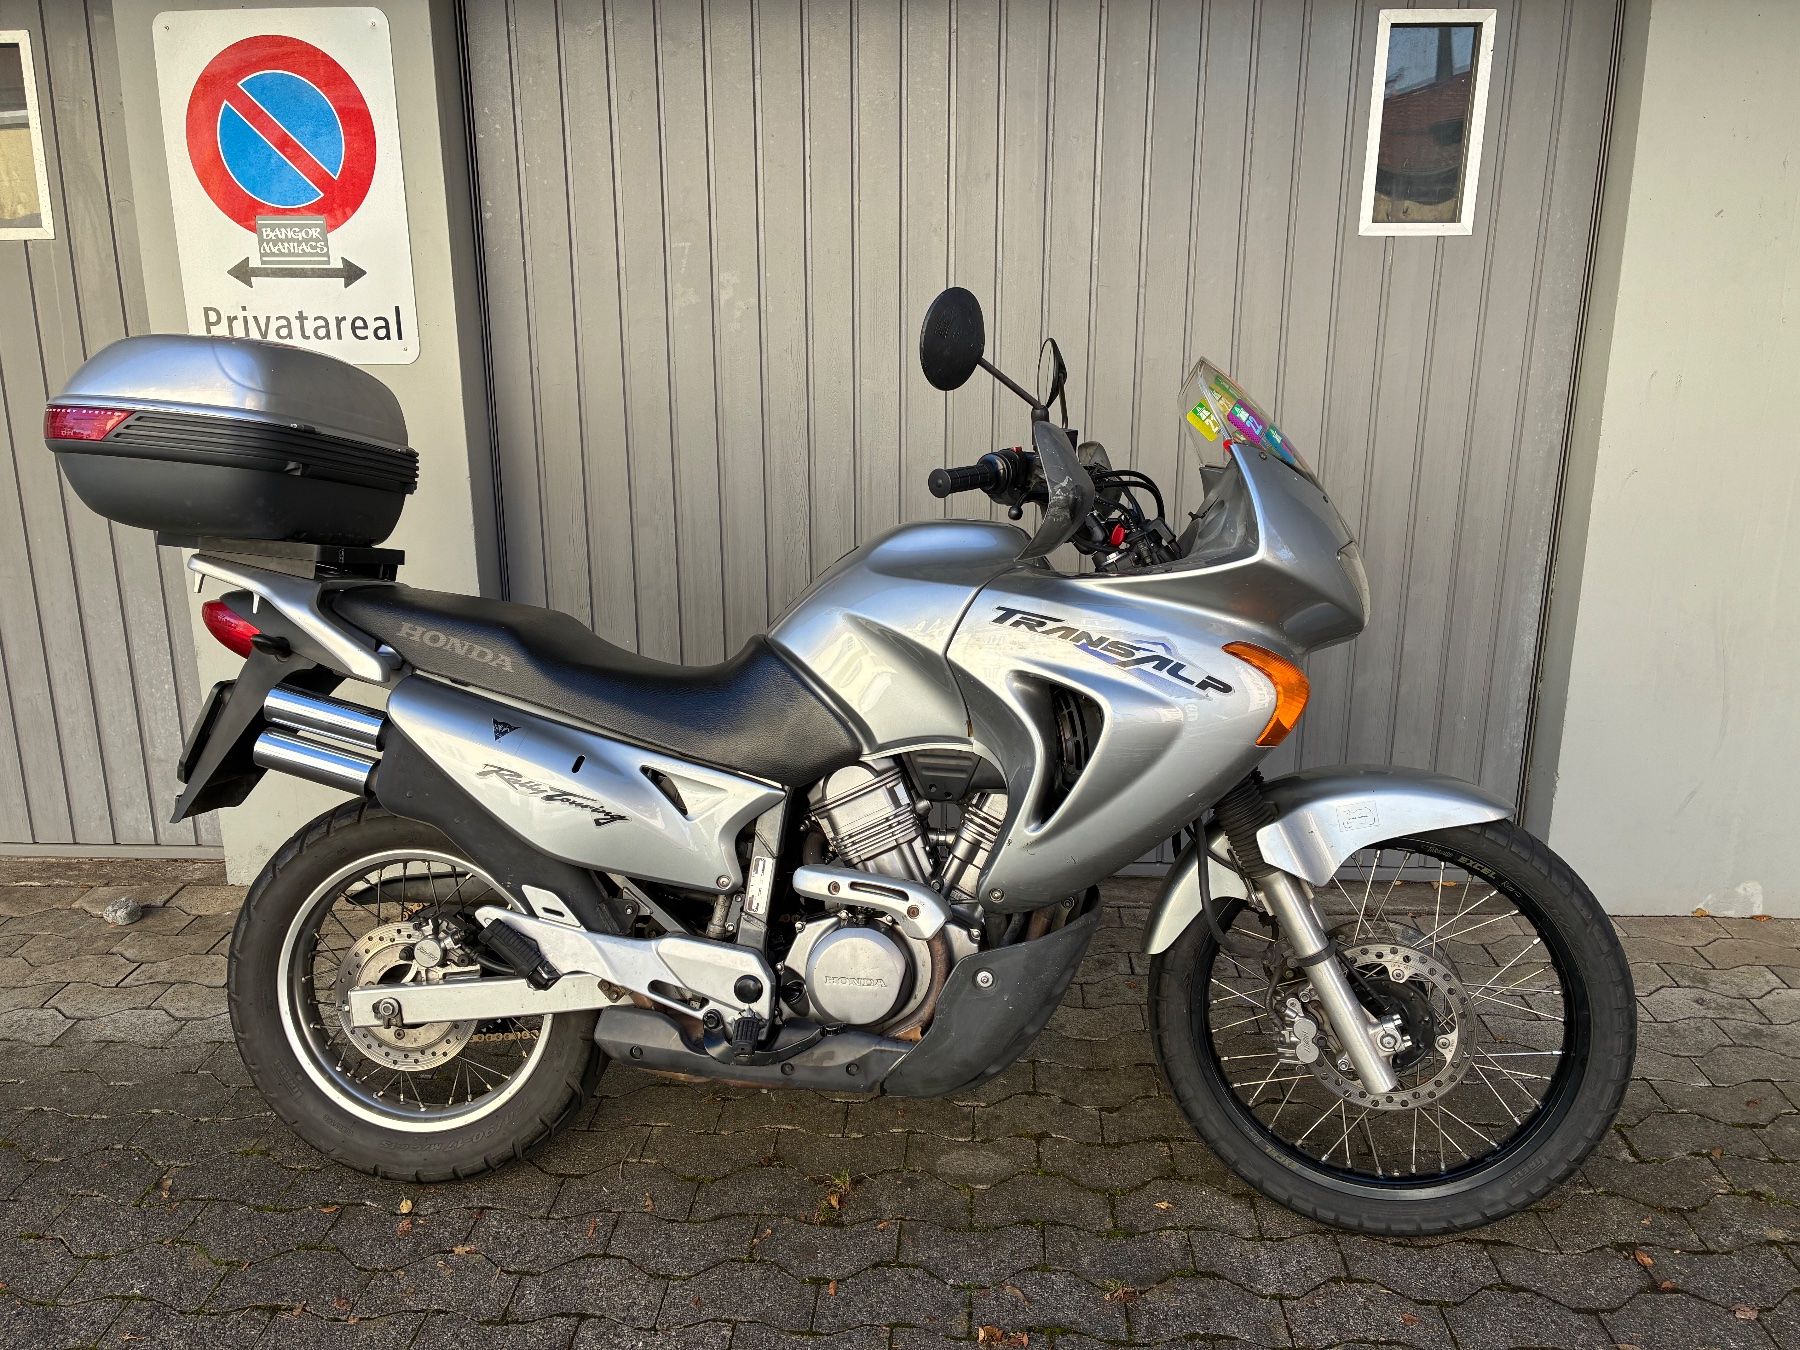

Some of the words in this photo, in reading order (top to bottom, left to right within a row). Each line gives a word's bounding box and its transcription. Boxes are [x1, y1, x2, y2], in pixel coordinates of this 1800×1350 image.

[262, 227, 323, 241] BANGOR
[260, 241, 328, 254] MANIACS
[203, 305, 403, 341] Privatareal
[396, 622, 515, 673] HONDA
[991, 606, 1235, 696] TRANSALP
[1458, 855, 1497, 880] EXCEL
[824, 975, 888, 988] HONDA
